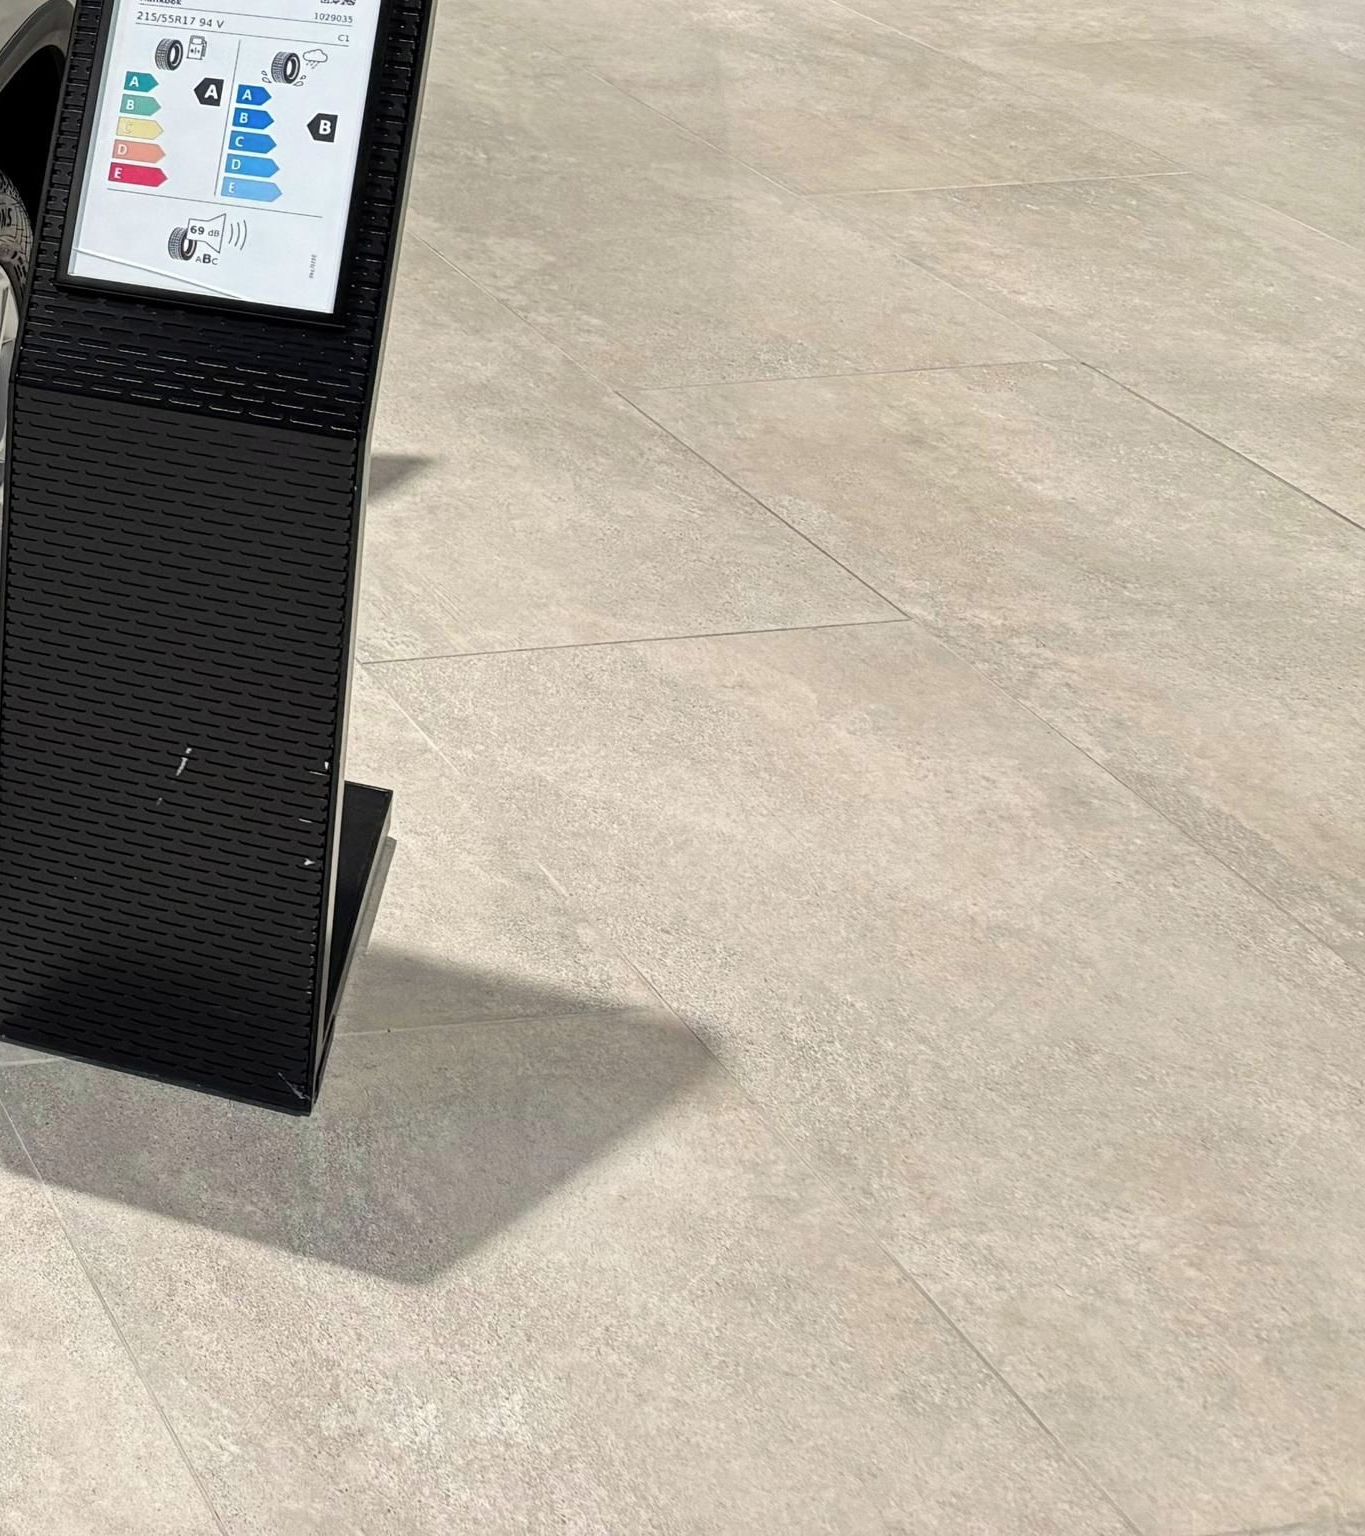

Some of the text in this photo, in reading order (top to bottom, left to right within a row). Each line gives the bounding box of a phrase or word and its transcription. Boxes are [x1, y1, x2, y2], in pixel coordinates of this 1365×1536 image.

[137, 11, 225, 29] 215/55R17 94 V
[314, 12, 353, 24] 1029035
[337, 34, 350, 43] C1
[129, 76, 139, 87] A
[204, 84, 218, 100] A
[242, 89, 252, 101] A
[126, 99, 135, 110] B
[239, 112, 249, 124] B
[319, 119, 331, 135] B
[235, 136, 244, 147] C
[117, 144, 128, 155] D
[231, 159, 241, 170] D
[114, 167, 123, 179] E
[228, 182, 236, 193] E
[190, 225, 205, 235] 69
